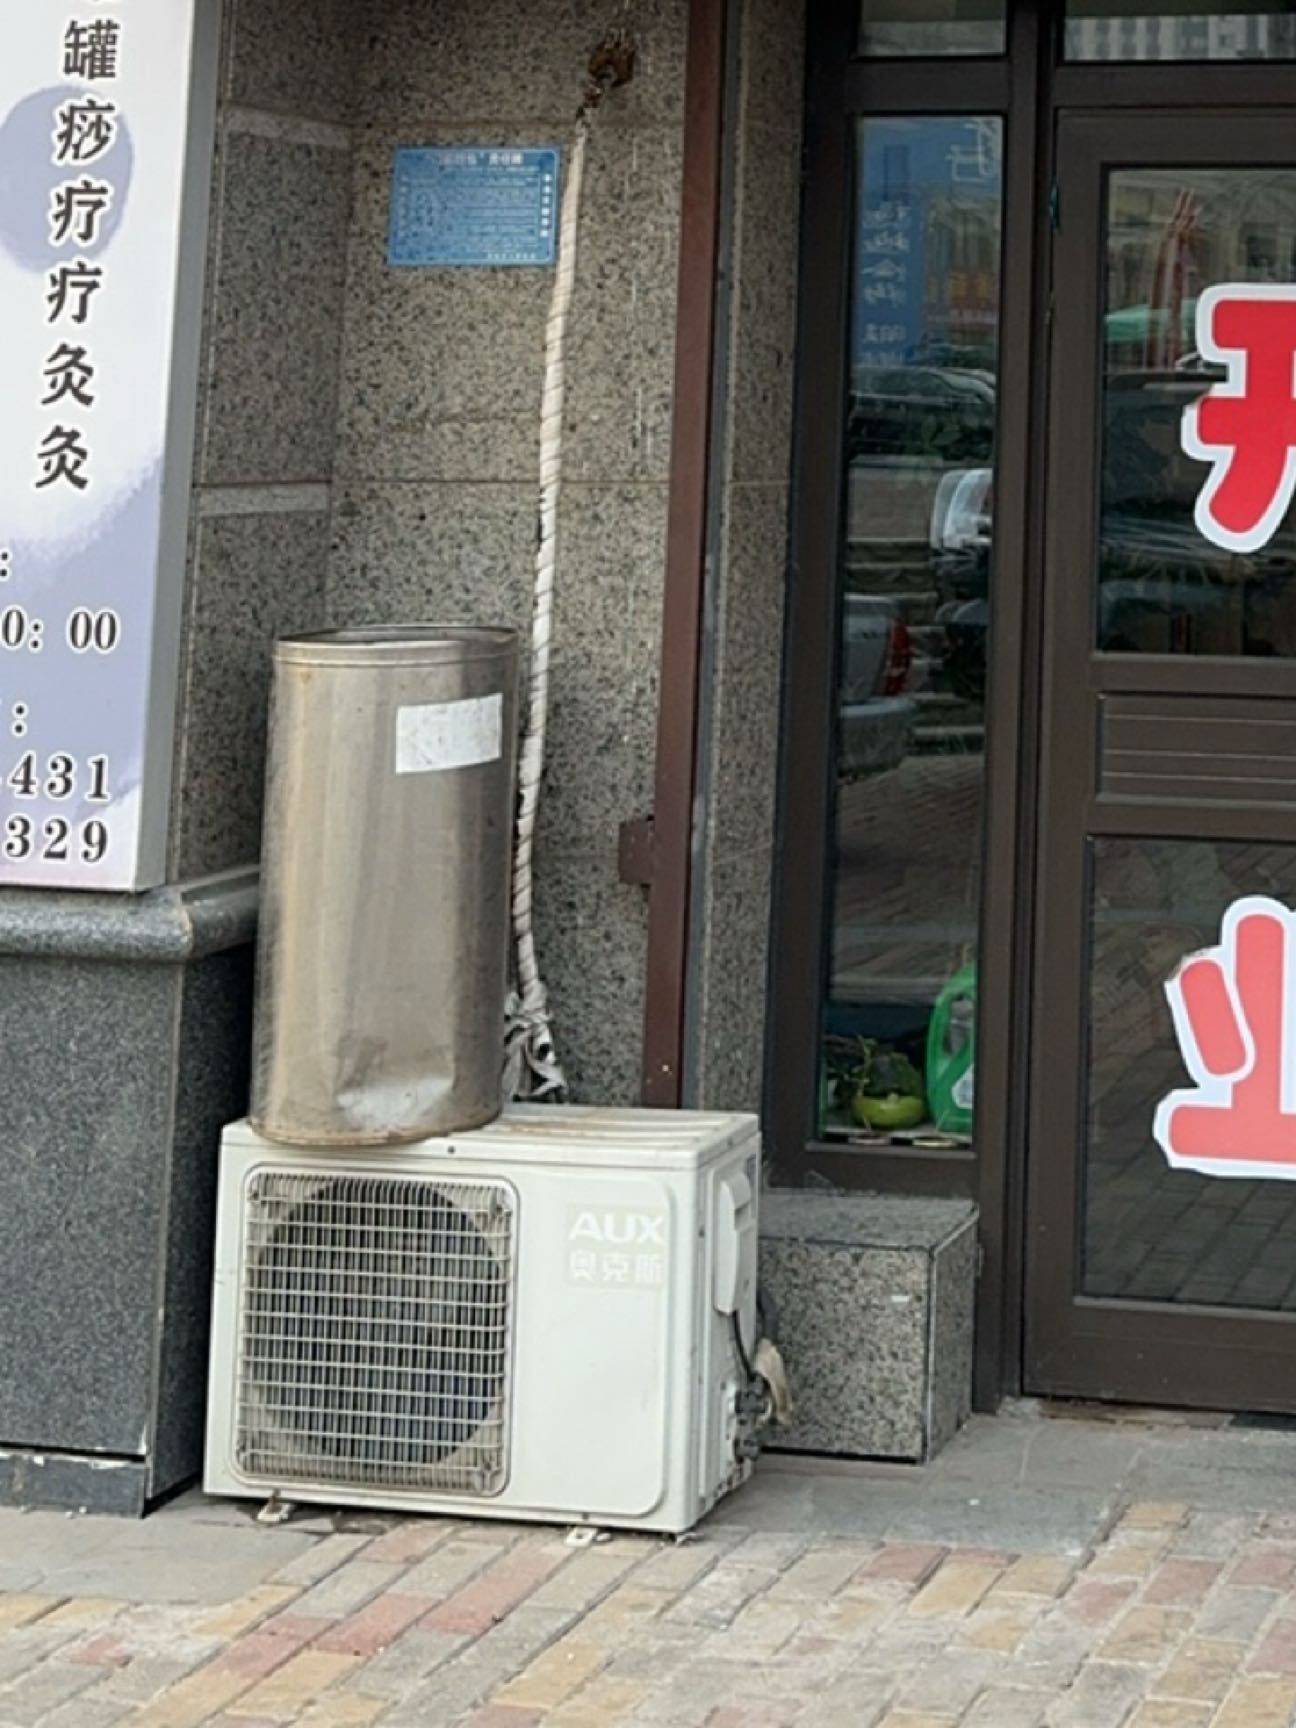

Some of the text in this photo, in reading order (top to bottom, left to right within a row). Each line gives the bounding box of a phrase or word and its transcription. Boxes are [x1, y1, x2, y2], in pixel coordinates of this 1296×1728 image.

[11, 754, 109, 800] 431
[6, 815, 108, 862] 329
[568, 1211, 665, 1244] AUX
